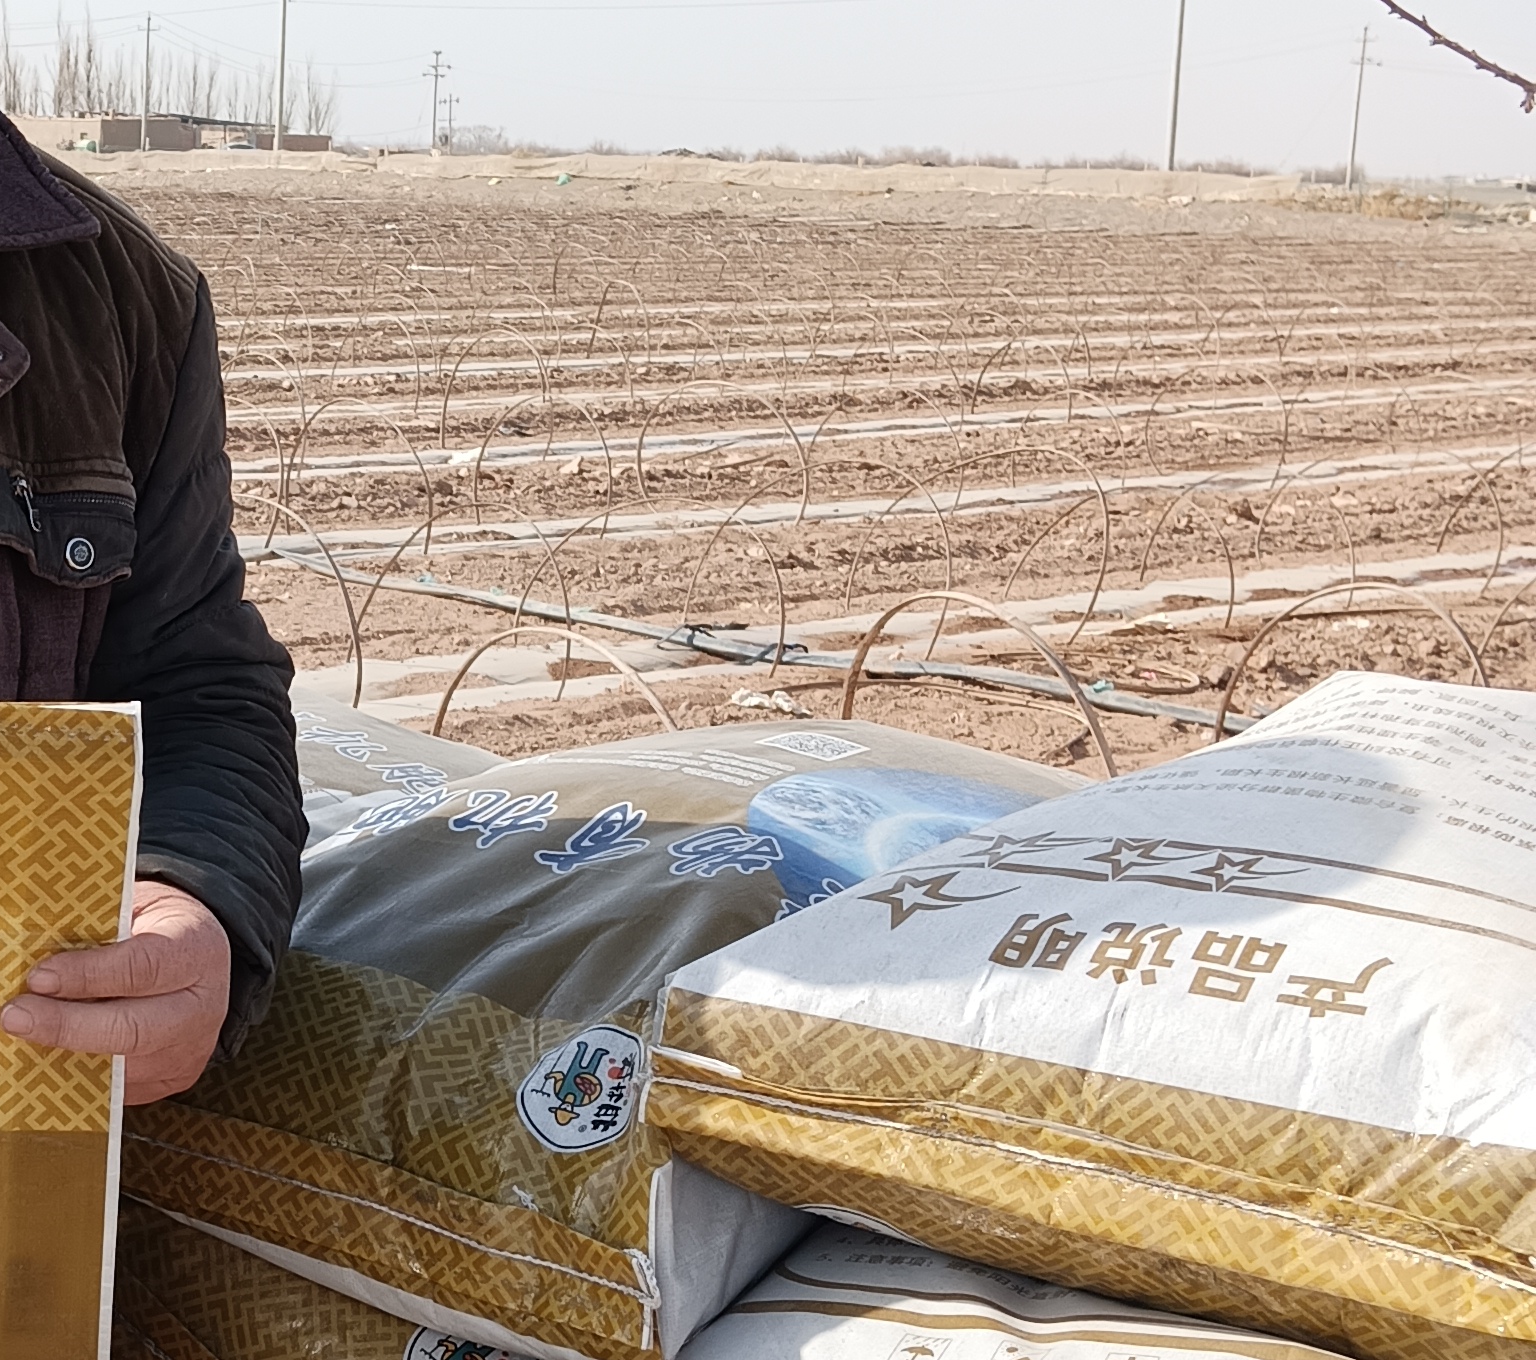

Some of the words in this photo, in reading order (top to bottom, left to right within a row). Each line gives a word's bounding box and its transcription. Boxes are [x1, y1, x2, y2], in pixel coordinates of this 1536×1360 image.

[296, 711, 448, 795] 机肥
[988, 912, 1394, 1018] 产品说明
